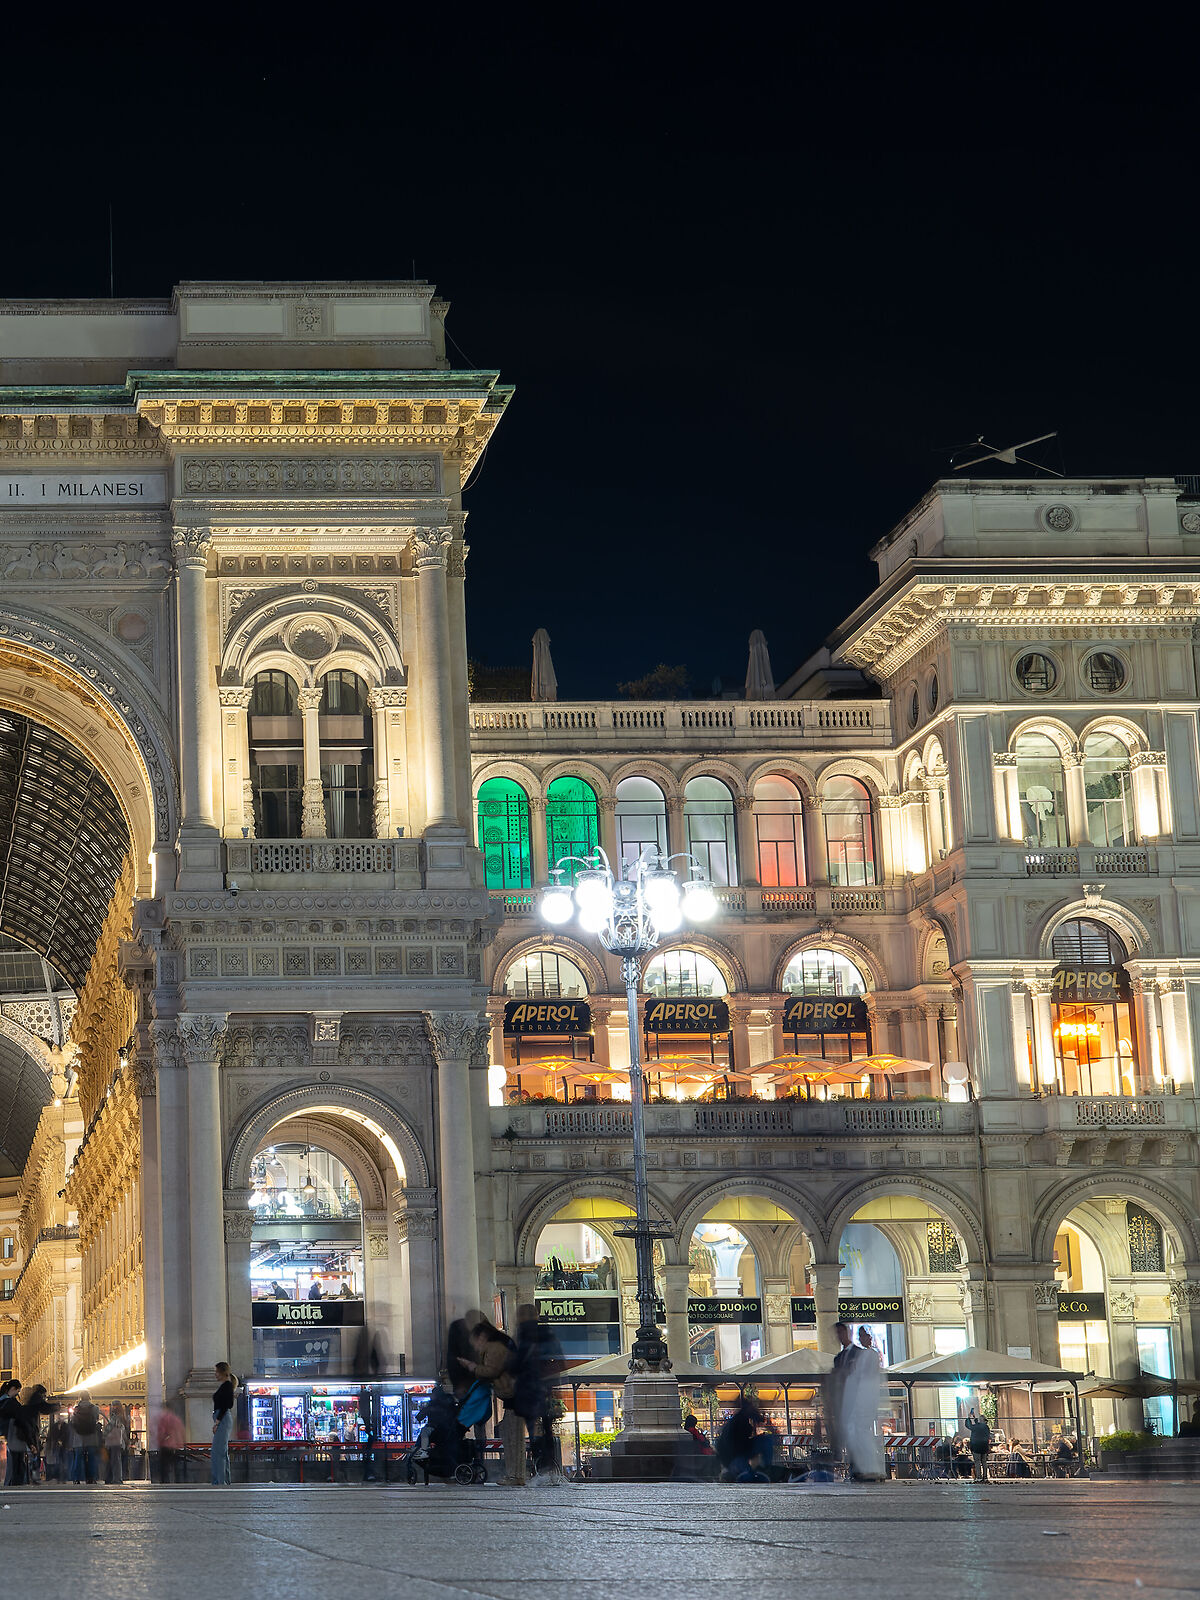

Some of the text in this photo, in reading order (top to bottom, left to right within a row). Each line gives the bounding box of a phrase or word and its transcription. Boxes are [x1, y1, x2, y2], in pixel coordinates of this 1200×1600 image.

[8, 483, 25, 496] II.
[41, 483, 46, 496] I
[58, 483, 144, 496] MILANESI
[1052, 970, 1120, 989] APEROL
[511, 1004, 579, 1023] APEROL
[649, 1002, 717, 1021] APEROL
[787, 1001, 856, 1020] APEROL
[277, 1304, 323, 1320] Motta
[540, 1300, 586, 1316] Motta
[720, 1303, 757, 1312] DUOMO
[794, 1303, 802, 1311] IL
[862, 1302, 900, 1311] DUOMO
[1059, 1301, 1090, 1313] & Co.
